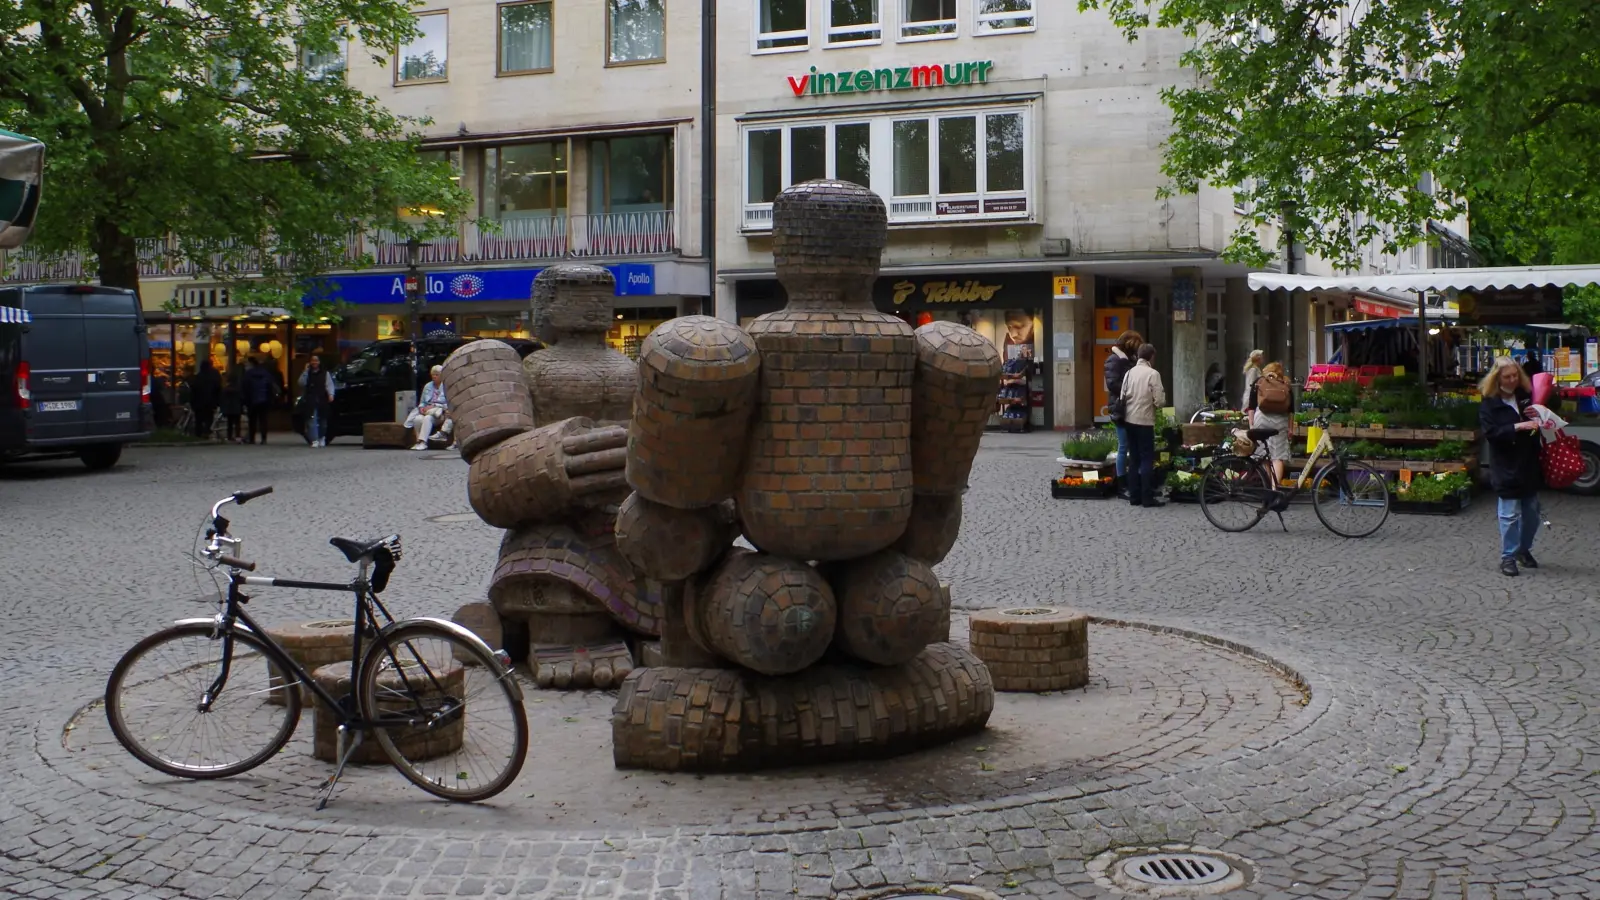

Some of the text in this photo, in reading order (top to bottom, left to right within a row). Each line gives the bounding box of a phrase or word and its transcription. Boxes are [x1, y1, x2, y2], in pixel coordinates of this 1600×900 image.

[786, 60, 994, 97] vinzenzmurr
[391, 276, 444, 298] Allo
[628, 271, 650, 286] Apollo
[922, 280, 1003, 304] Tchibo
